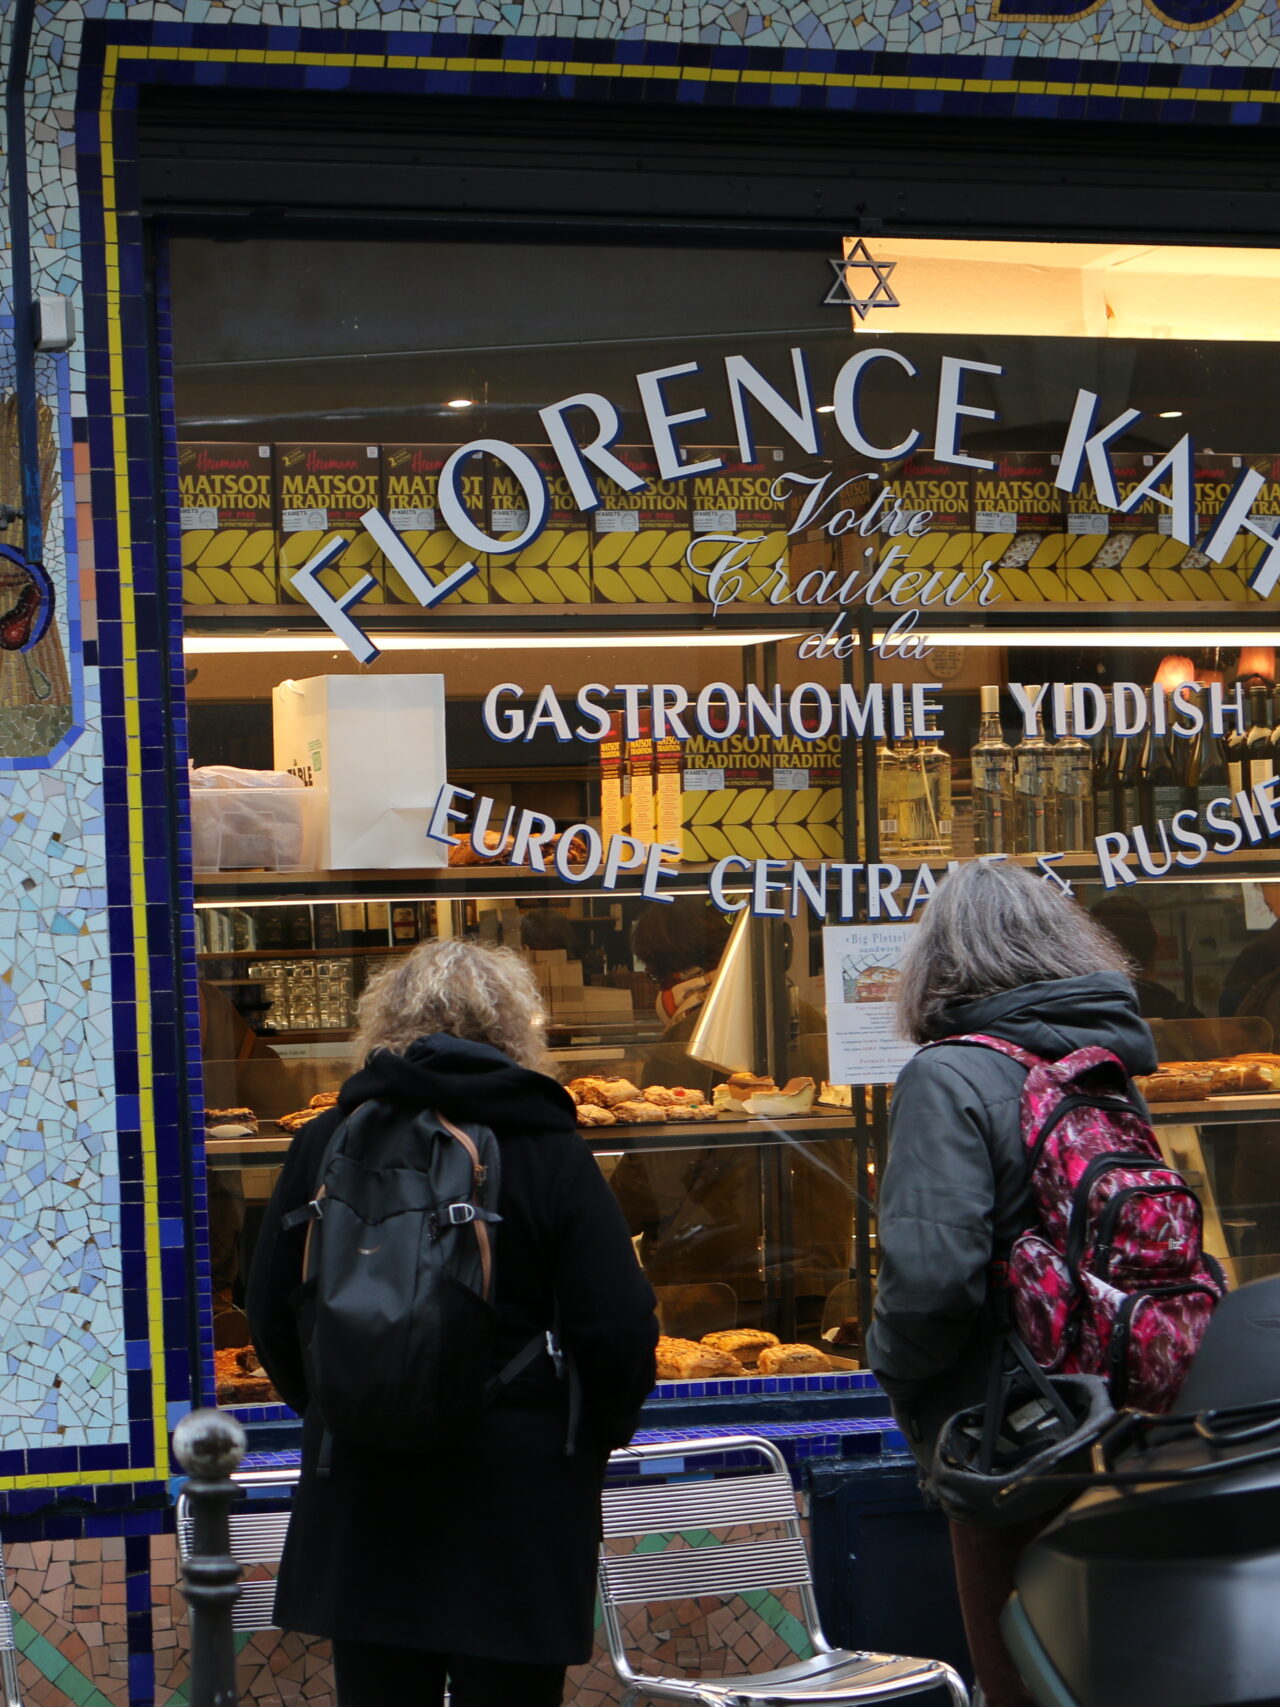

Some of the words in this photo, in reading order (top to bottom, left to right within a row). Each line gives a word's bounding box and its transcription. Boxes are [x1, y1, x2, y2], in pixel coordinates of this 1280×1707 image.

[179, 475, 271, 494] MATSOT
[282, 475, 378, 494] MATSOT
[388, 476, 484, 495] MATT
[694, 477, 784, 496] MATSOT
[883, 481, 968, 499] MATSOT
[282, 494, 379, 509] TRADITION
[289, 347, 1006, 665] FLORENCE
[693, 496, 784, 511] TRADITION
[770, 471, 933, 537] Votre
[883, 499, 969, 513] TADITION
[975, 500, 1061, 513] TRADITION
[687, 534, 1002, 618] Traiteur
[798, 611, 856, 661] de
[868, 608, 934, 661] la
[482, 682, 946, 741] GASTRONOMIE
[1007, 680, 1245, 739] YIDDISH
[685, 735, 769, 753] MATSOT
[685, 754, 769, 768] TRADITION
[425, 783, 683, 904] EUROPE
[708, 852, 1009, 922] CENTRA
[1094, 776, 1280, 891] RUSSIE
